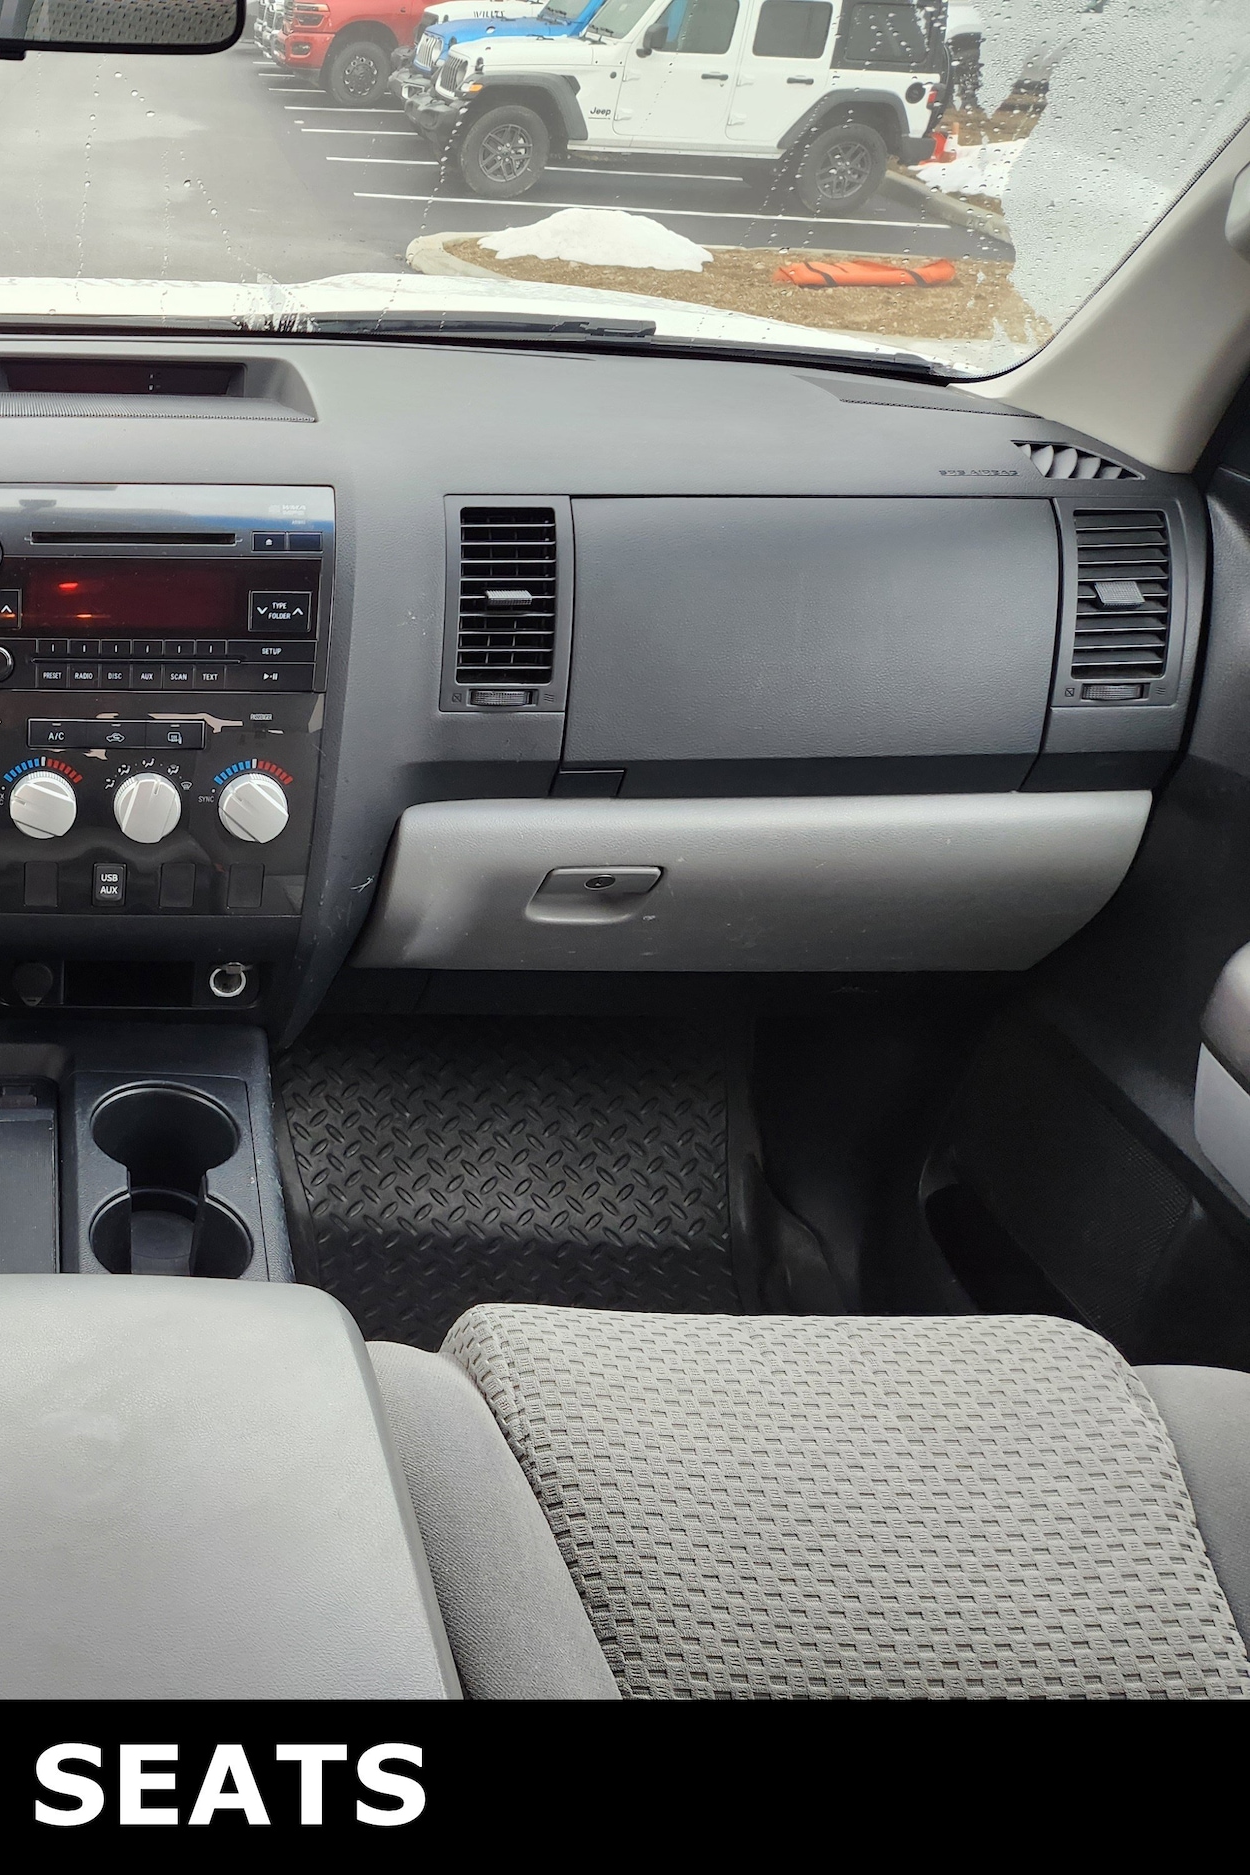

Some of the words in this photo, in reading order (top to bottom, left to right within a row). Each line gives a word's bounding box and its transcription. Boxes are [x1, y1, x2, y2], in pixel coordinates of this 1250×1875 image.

[590, 106, 611, 116] Jeep
[268, 612, 291, 620] FOLDER
[43, 672, 62, 680] PRESET
[74, 672, 93, 680] RADIO
[107, 672, 122, 680] DISC
[140, 673, 154, 681] AUX
[170, 673, 188, 681] SCAN
[202, 673, 218, 681] TEXT
[48, 731, 65, 741] A/C
[198, 795, 215, 803] SYNC
[100, 873, 119, 882] USB
[100, 885, 118, 895] AUX
